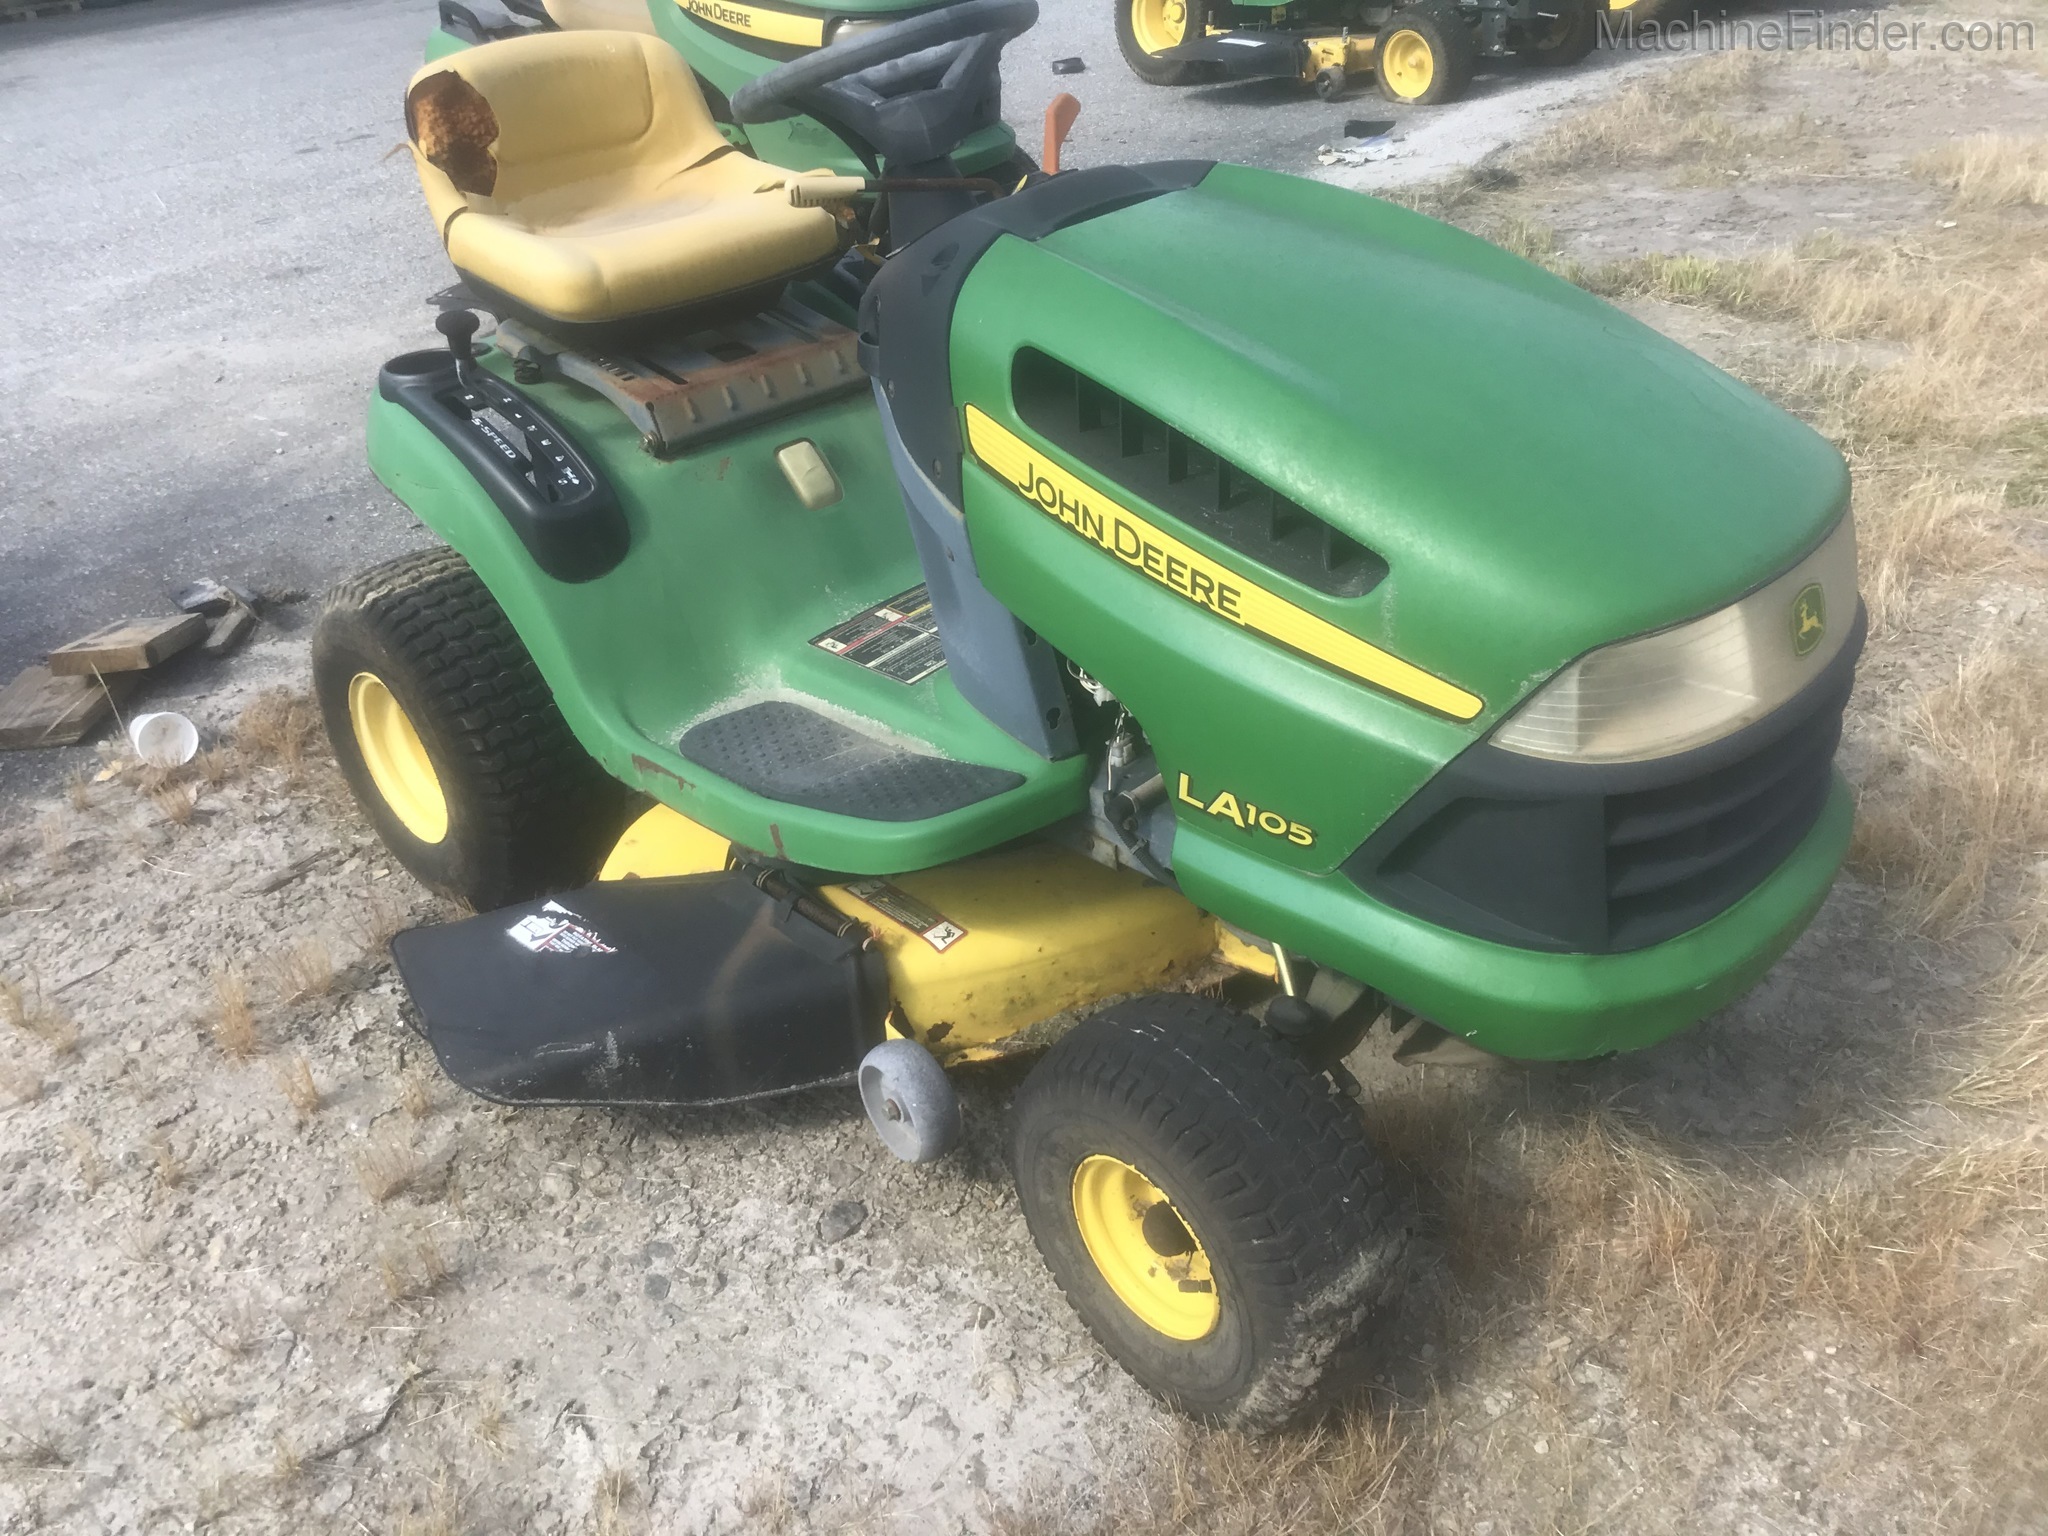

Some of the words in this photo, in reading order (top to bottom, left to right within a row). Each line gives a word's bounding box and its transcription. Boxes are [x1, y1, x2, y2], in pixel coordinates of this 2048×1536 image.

[687, 0, 713, 17] JOHN
[714, 3, 751, 27] DEERE
[1018, 462, 1104, 543] JOHN
[1114, 517, 1241, 619] DEERE
[1178, 771, 1315, 847] LA105
